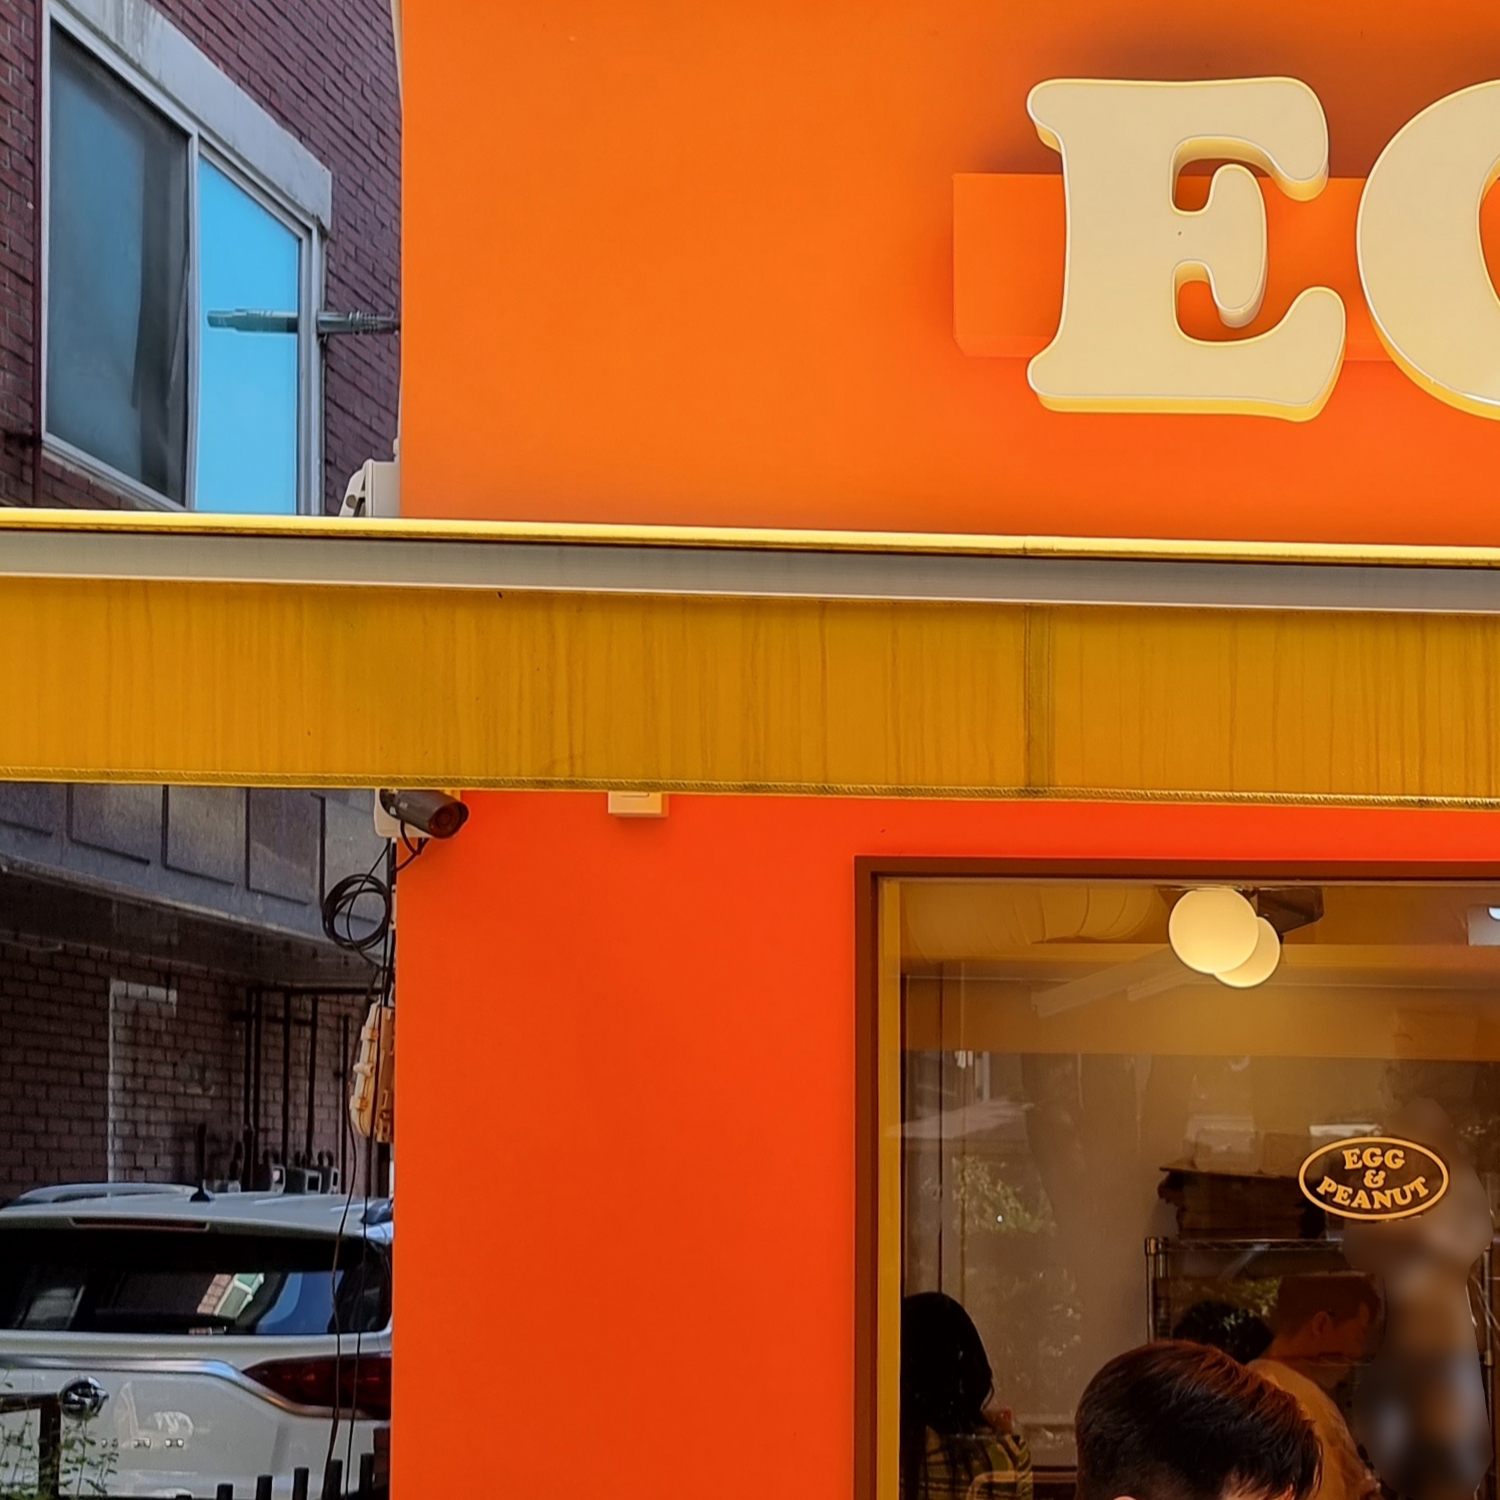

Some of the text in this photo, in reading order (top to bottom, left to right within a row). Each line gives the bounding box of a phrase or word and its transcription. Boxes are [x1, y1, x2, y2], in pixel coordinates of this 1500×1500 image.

[1342, 1147, 1405, 1169] EGG
[1363, 1169, 1386, 1188] &
[1316, 1175, 1429, 1209] PEANUT
